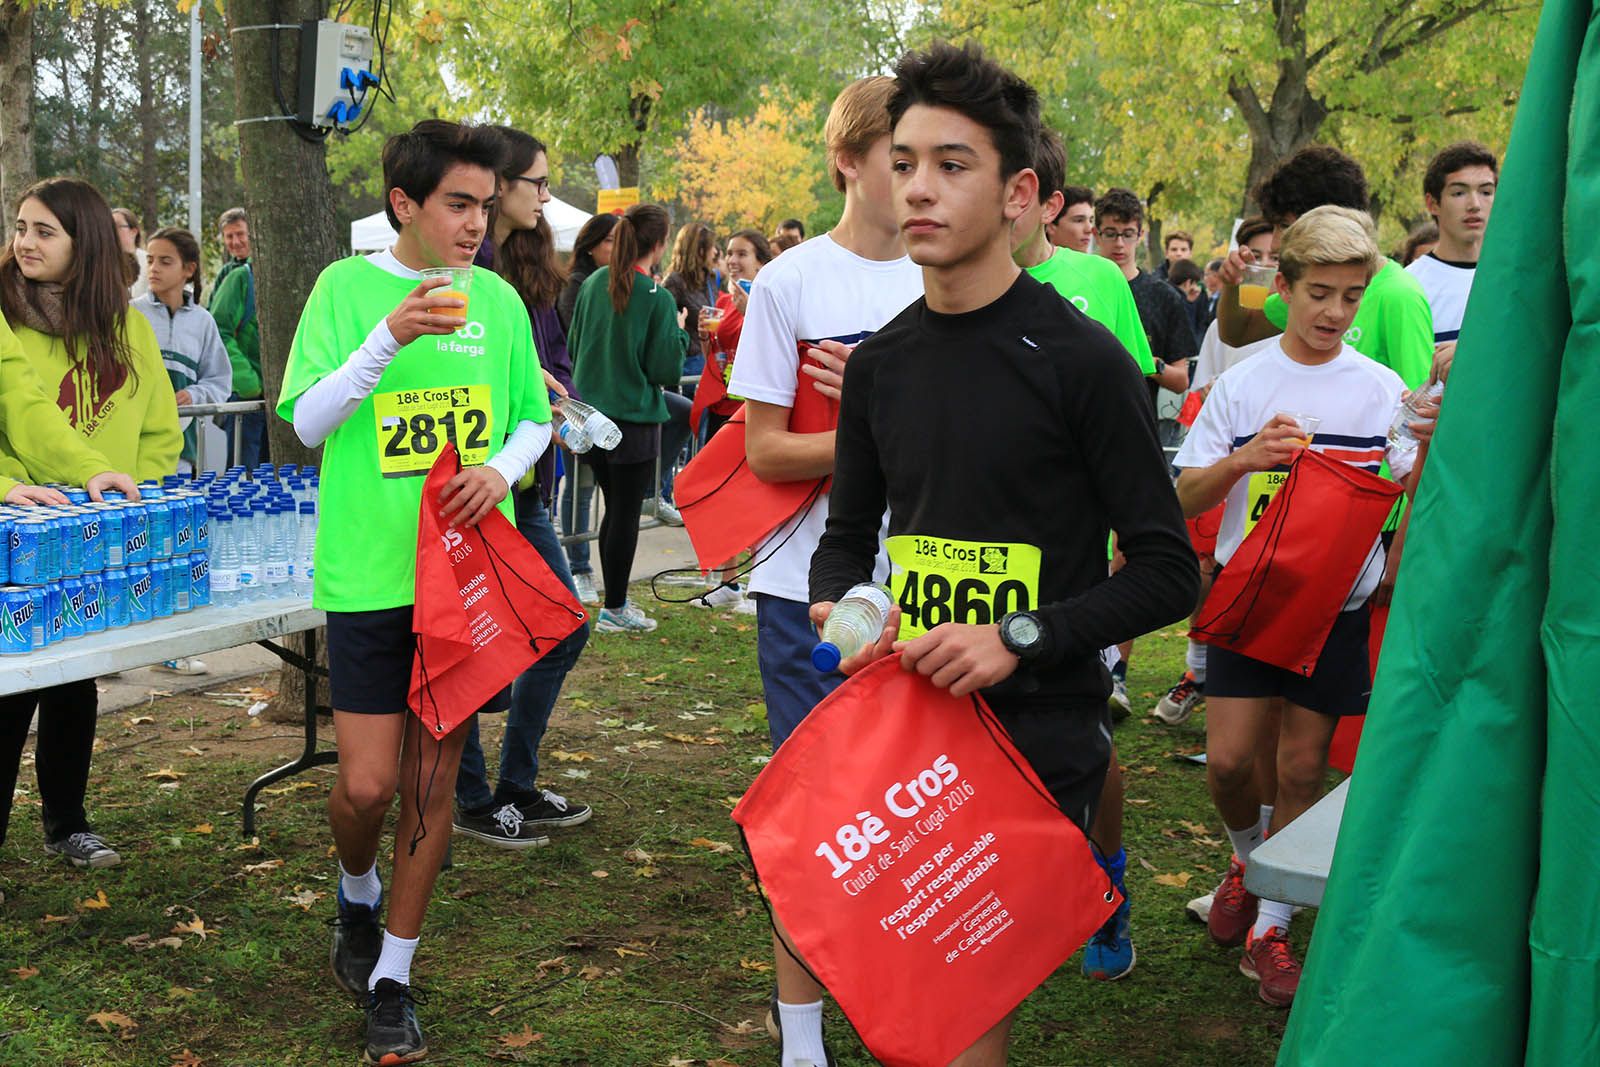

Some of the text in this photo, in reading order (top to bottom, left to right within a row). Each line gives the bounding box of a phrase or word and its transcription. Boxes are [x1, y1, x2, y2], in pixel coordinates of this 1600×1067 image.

[97, 400, 115, 419] Cros
[396, 390, 450, 406] 18è Cros
[382, 408, 489, 458] 2812
[452, 542, 474, 565] 2016
[915, 538, 977, 562] 18è Cros
[459, 573, 487, 597] nsable
[899, 569, 1030, 632] 4860
[0, 599, 34, 643] ARIUS
[471, 615, 494, 637] eneral
[472, 622, 499, 647] talunya
[815, 753, 960, 879] 18è Cros
[842, 779, 976, 897] Ciutat de Sant Cugat 2016
[880, 831, 997, 932] l'esport responsable
[901, 841, 956, 893] junts per
[896, 897, 946, 941] l'esport
[943, 851, 1001, 903] saludable
[963, 897, 1003, 932] General
[945, 949, 961, 964] de
[958, 909, 1010, 952] Catalunya
